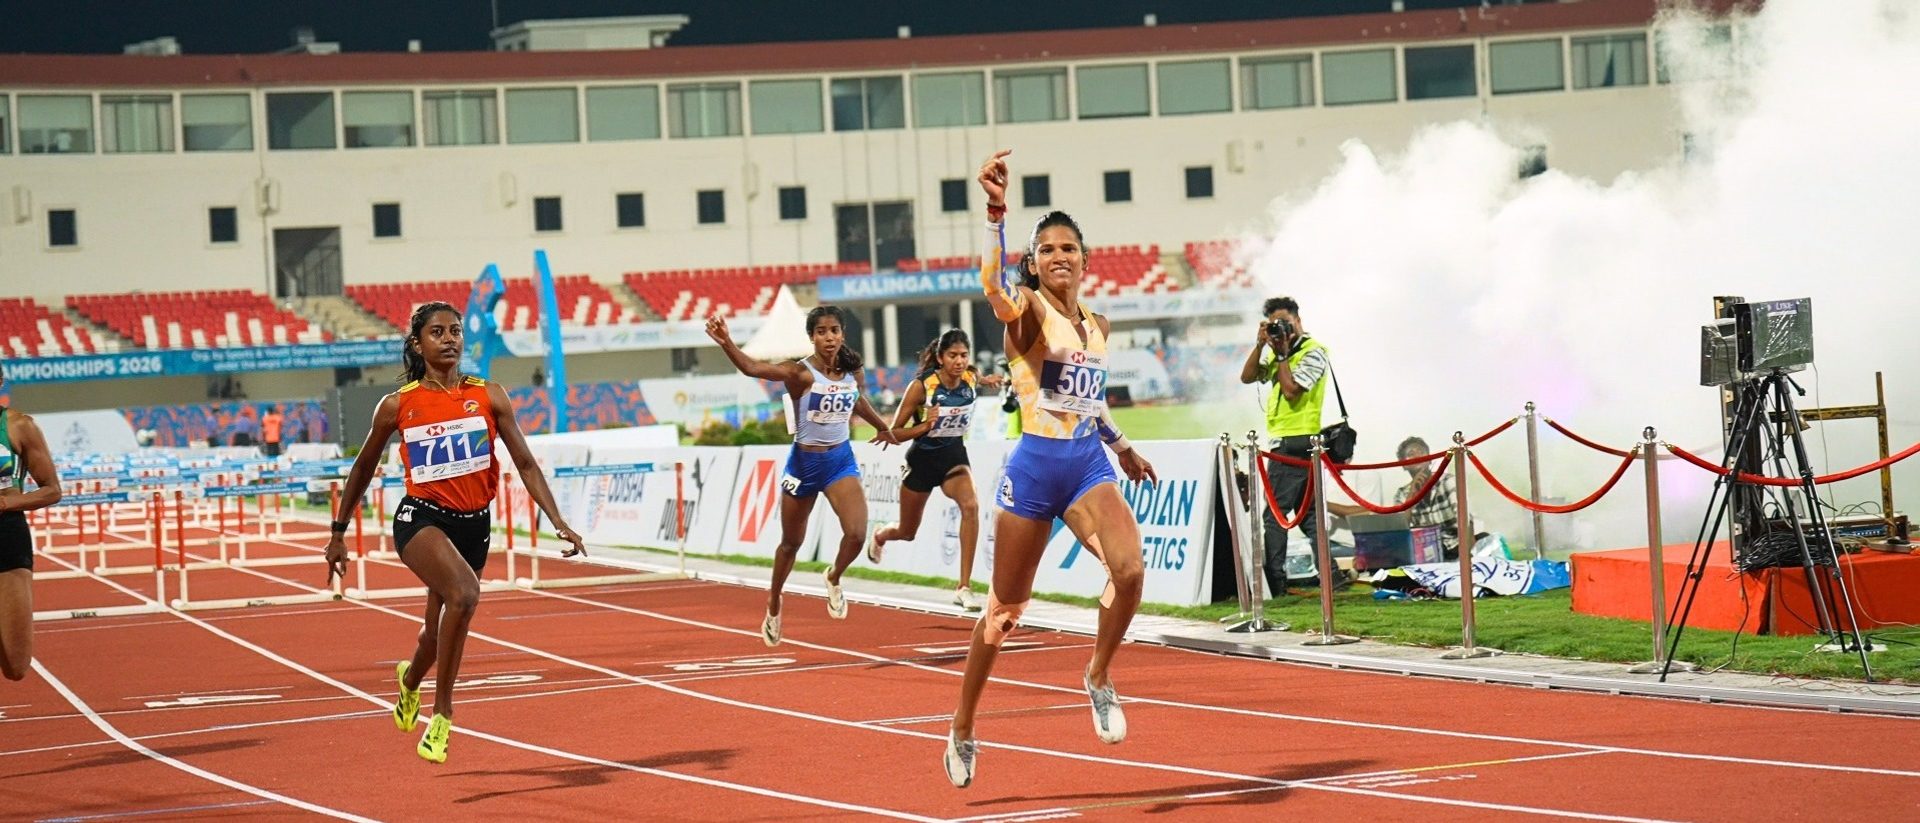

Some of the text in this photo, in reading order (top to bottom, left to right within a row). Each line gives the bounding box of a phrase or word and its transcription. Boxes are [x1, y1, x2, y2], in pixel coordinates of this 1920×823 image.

[843, 275, 934, 297] KALINGA
[119, 356, 162, 373] 2026
[1057, 365, 1102, 399] 508
[819, 393, 855, 413] 663
[940, 413, 970, 429] 643
[419, 432, 472, 466] 711
[1119, 479, 1197, 526] NDIAN
